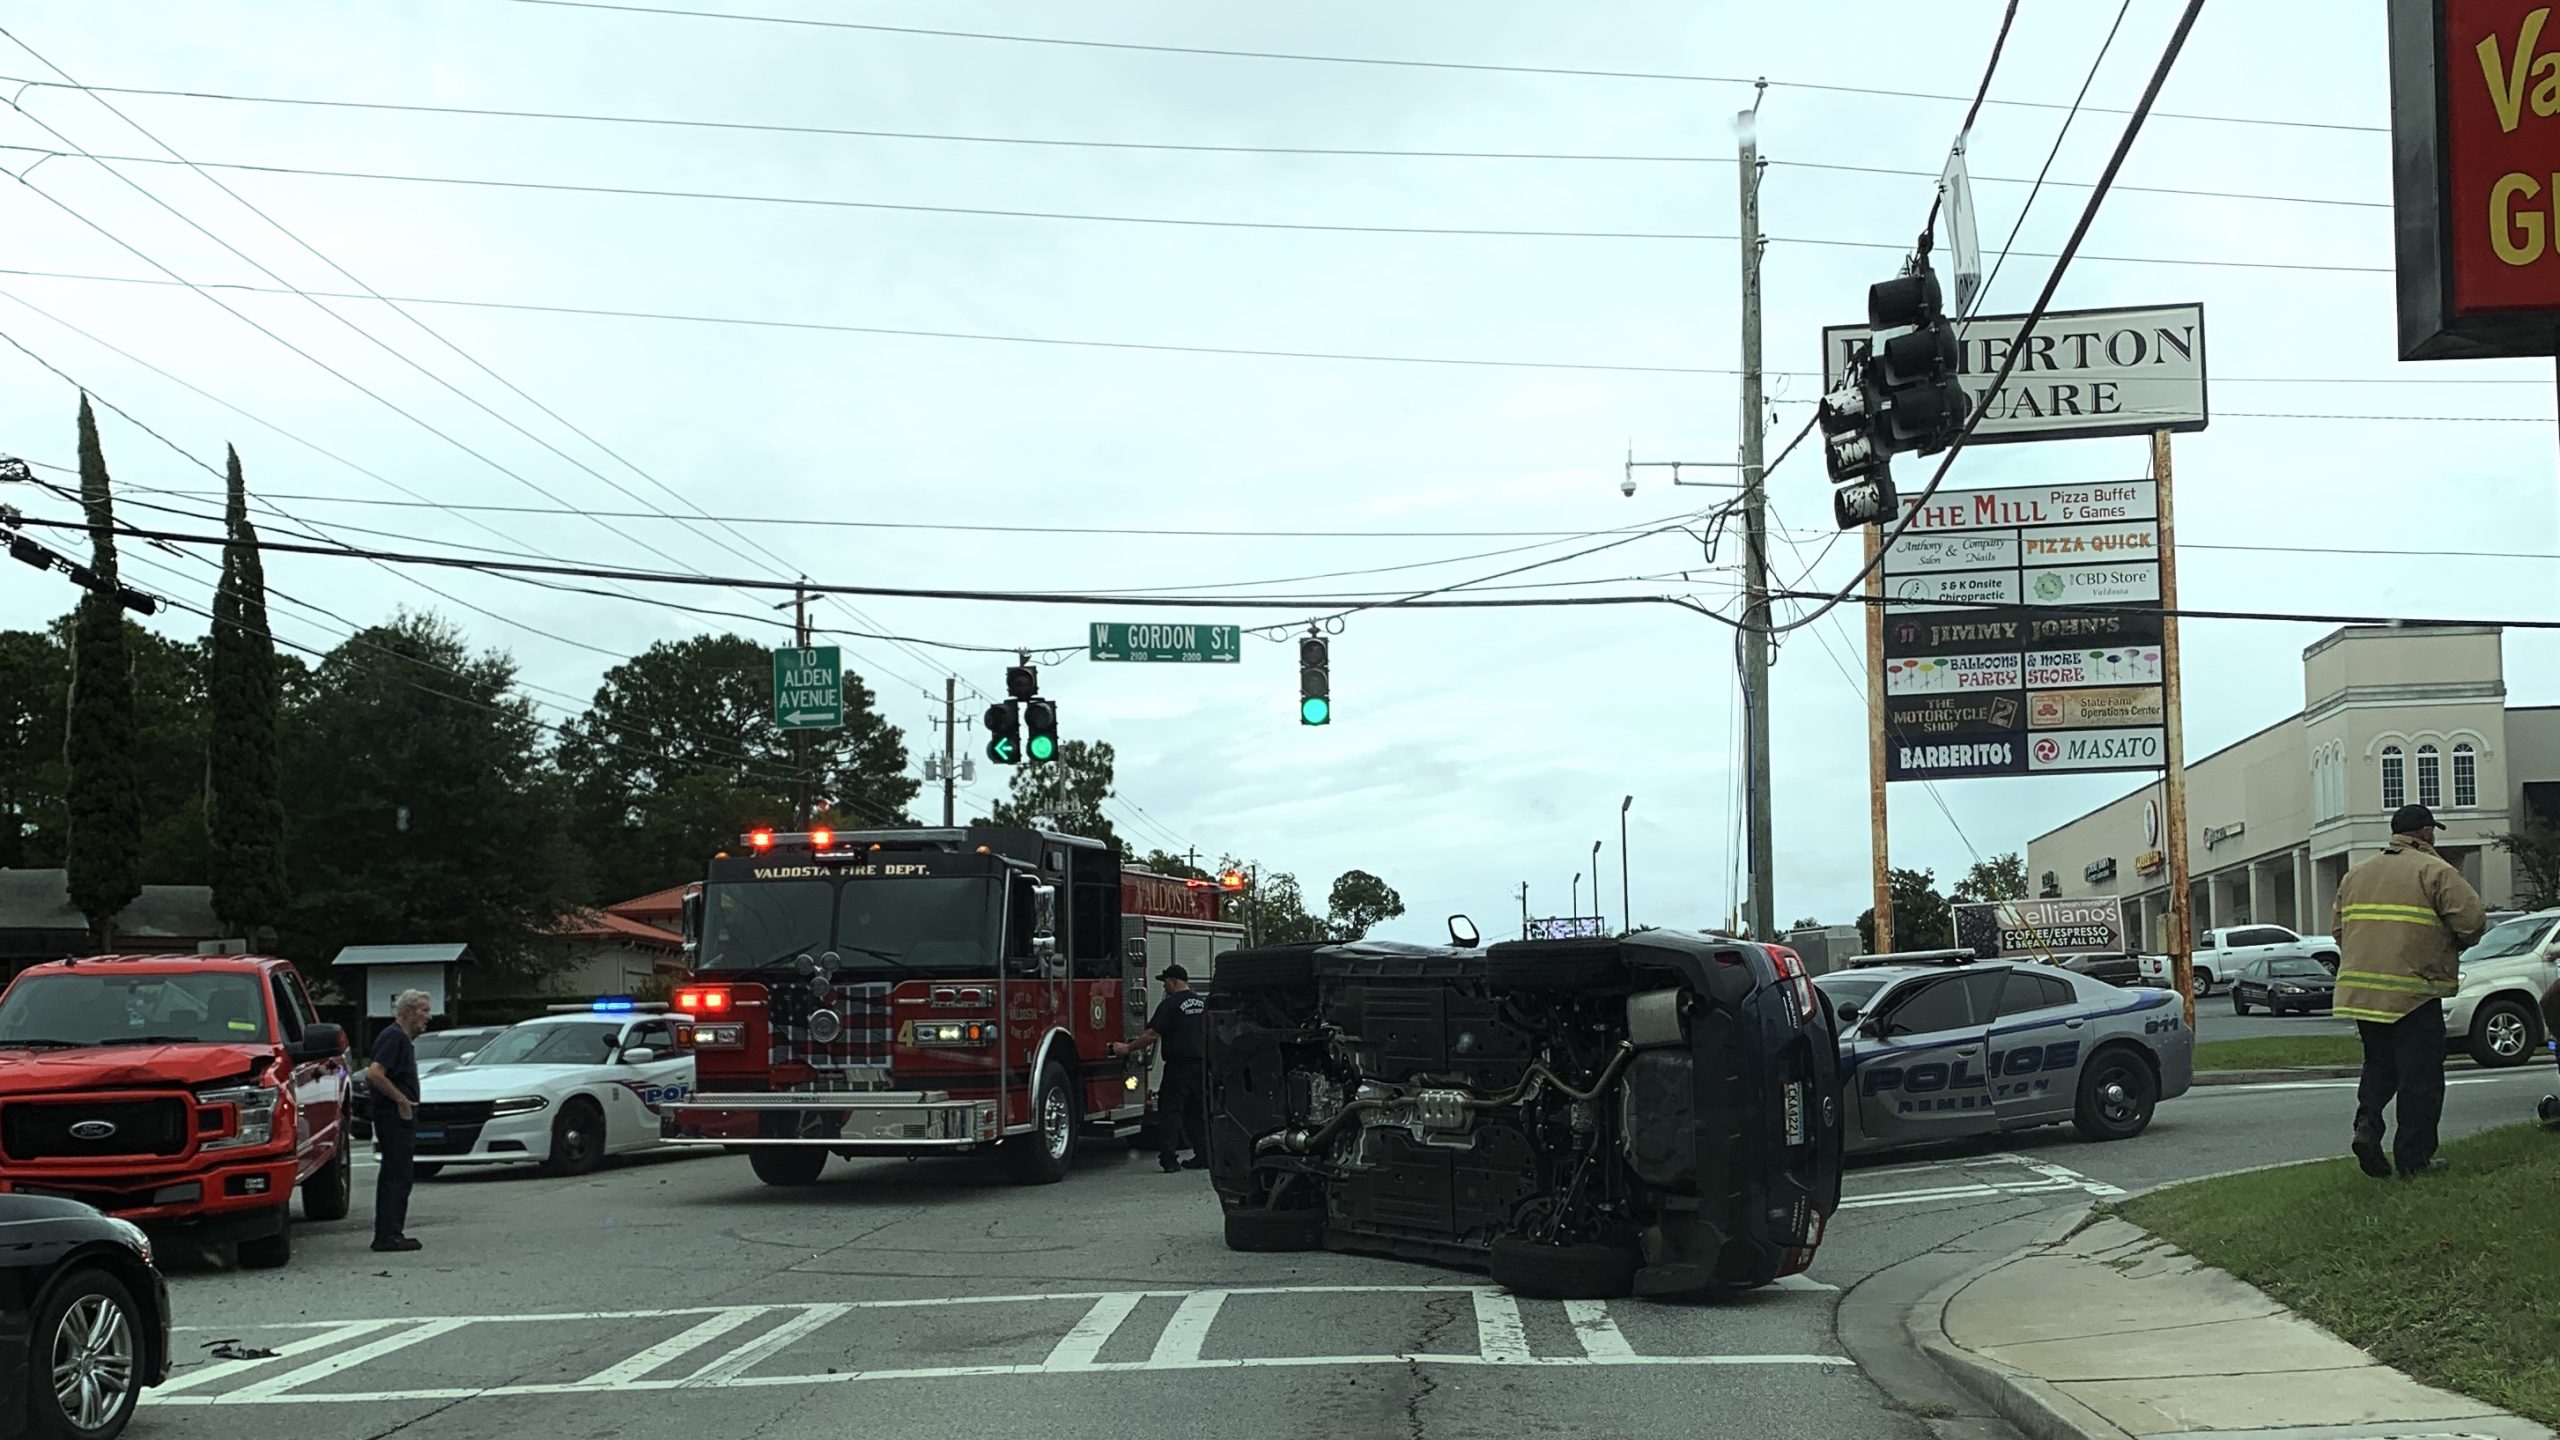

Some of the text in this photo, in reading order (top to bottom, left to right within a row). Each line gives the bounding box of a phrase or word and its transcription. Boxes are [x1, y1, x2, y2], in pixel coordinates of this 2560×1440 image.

[2489, 172, 2560, 265] G
[1962, 382, 2122, 420] UARE
[2051, 488, 2136, 504] Pizza Buffet
[1903, 494, 2047, 528] THE MILL
[2063, 506, 2126, 519] & Games
[1897, 539, 2005, 557] Anthony & Company
[2027, 532, 2151, 554] PIZZA QUICK
[1918, 552, 1996, 565] Salon Nails
[1941, 579, 2002, 590] S & K Onsite
[2076, 573, 2107, 585] CBD
[2111, 571, 2147, 583] Store
[1939, 590, 2005, 602] Chiropractic
[1096, 624, 1235, 650] W. GORDON ST.
[1930, 617, 2121, 646] JIMMY JOHN'S
[797, 650, 817, 668] TO
[1130, 652, 1201, 662] 2100 2000
[1950, 653, 2082, 670] BALLOONS & MORE
[784, 669, 832, 687] ALDEN
[1958, 668, 2085, 688] PARTY STORE
[779, 689, 838, 708] AVENUE
[1925, 698, 1955, 709] THE
[2080, 698, 2106, 707] State
[1893, 707, 1988, 724] MOTORCYCLE
[2080, 706, 2161, 719] Operations Center
[1923, 722, 1959, 732] SHOP
[1900, 742, 2012, 769] BARBERITOS
[2067, 736, 2157, 760] MASATO
[754, 864, 931, 879] VALDOSTA FIRE DEPT.
[2025, 903, 2117, 925] ellianos
[2070, 937, 2087, 945] ALL
[2089, 936, 2109, 945] DAY
[897, 1020, 913, 1047] 4
[1862, 1040, 2080, 1097] POLICE
